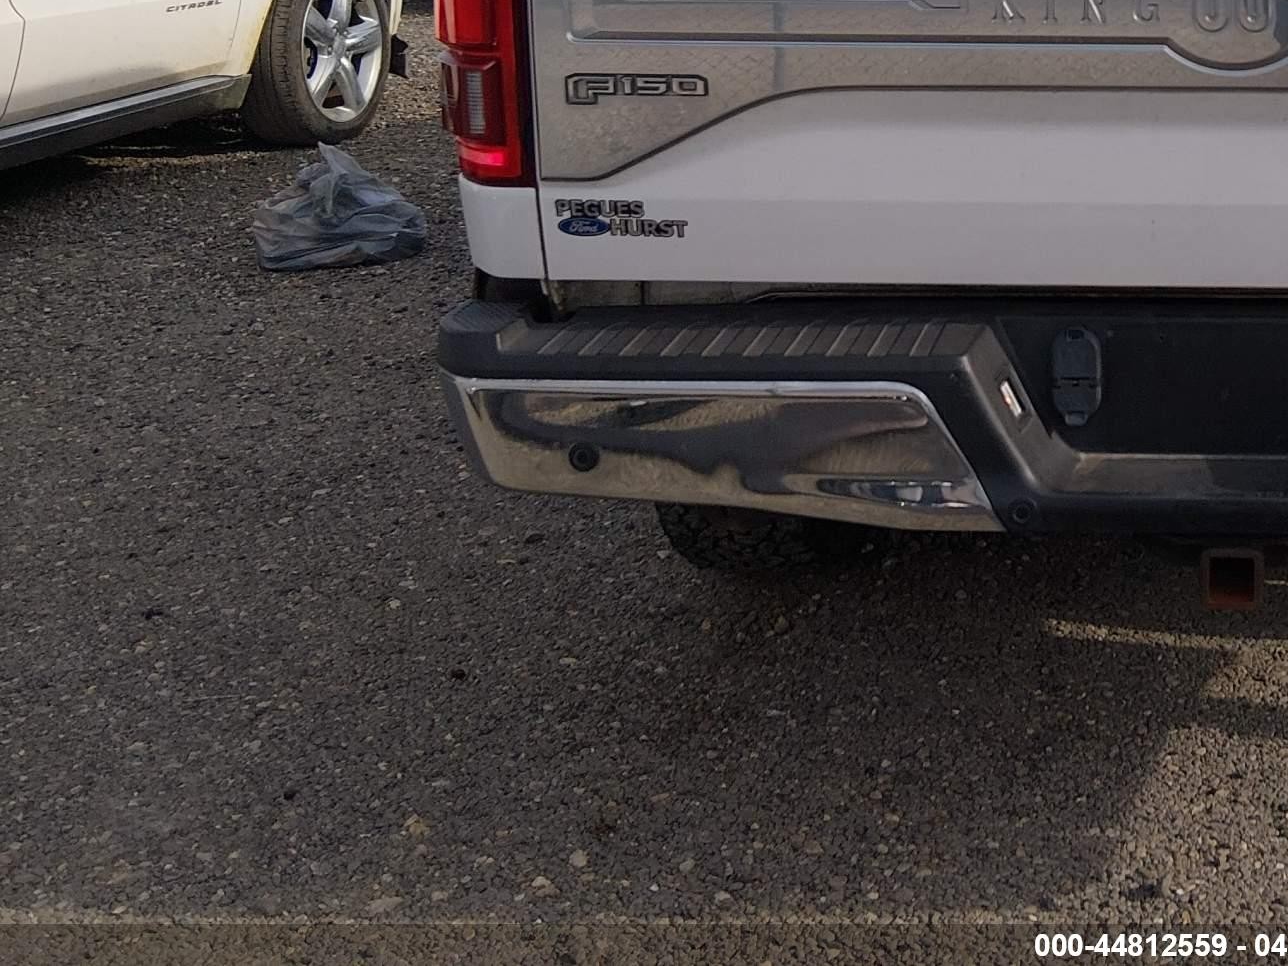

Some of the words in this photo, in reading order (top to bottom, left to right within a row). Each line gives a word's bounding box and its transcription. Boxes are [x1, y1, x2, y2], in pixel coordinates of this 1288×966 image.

[565, 73, 709, 105] F150
[555, 199, 645, 218] PEGUES
[609, 218, 689, 238] HURST
